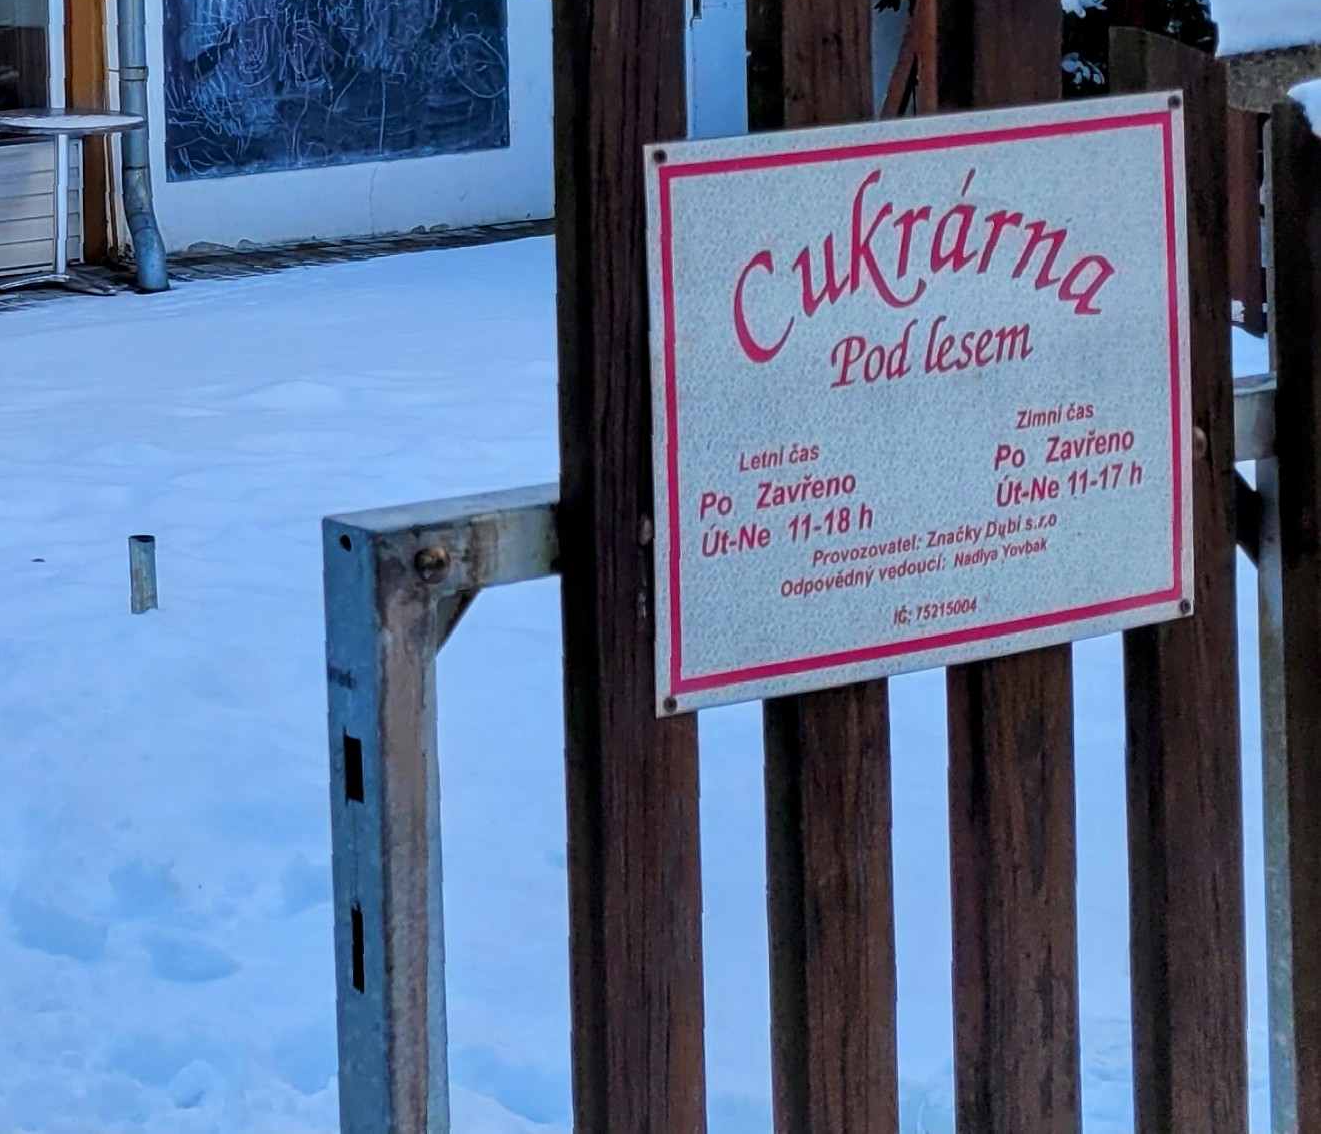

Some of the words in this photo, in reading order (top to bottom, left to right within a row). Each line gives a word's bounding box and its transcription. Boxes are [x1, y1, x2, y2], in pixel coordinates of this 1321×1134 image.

[733, 168, 1116, 364] Cukrárna
[829, 319, 917, 388] Pod
[925, 316, 1034, 375] lesem
[1016, 403, 1063, 430] Zimní
[1066, 402, 1094, 422] čas
[738, 445, 783, 472] Letní
[788, 443, 820, 464] čas
[994, 443, 1026, 472] Po
[1045, 429, 1135, 464] Zavřeno
[699, 490, 733, 522] Po
[756, 474, 856, 510] Zavřeno
[996, 474, 1060, 508] Út-Ne
[1067, 463, 1123, 497] 11-17
[1129, 460, 1143, 486] h
[701, 523, 771, 558] Út-Ne
[787, 506, 851, 544] 11-18
[858, 501, 873, 530] h
[812, 535, 921, 567] Provozovatel:
[926, 526, 983, 549] Značky
[780, 566, 874, 598] Odpovědný
[878, 553, 946, 581] vedoucí:
[953, 546, 998, 566] Nadlya
[1002, 537, 1048, 558] Yovbak
[916, 595, 977, 621] 75215004
